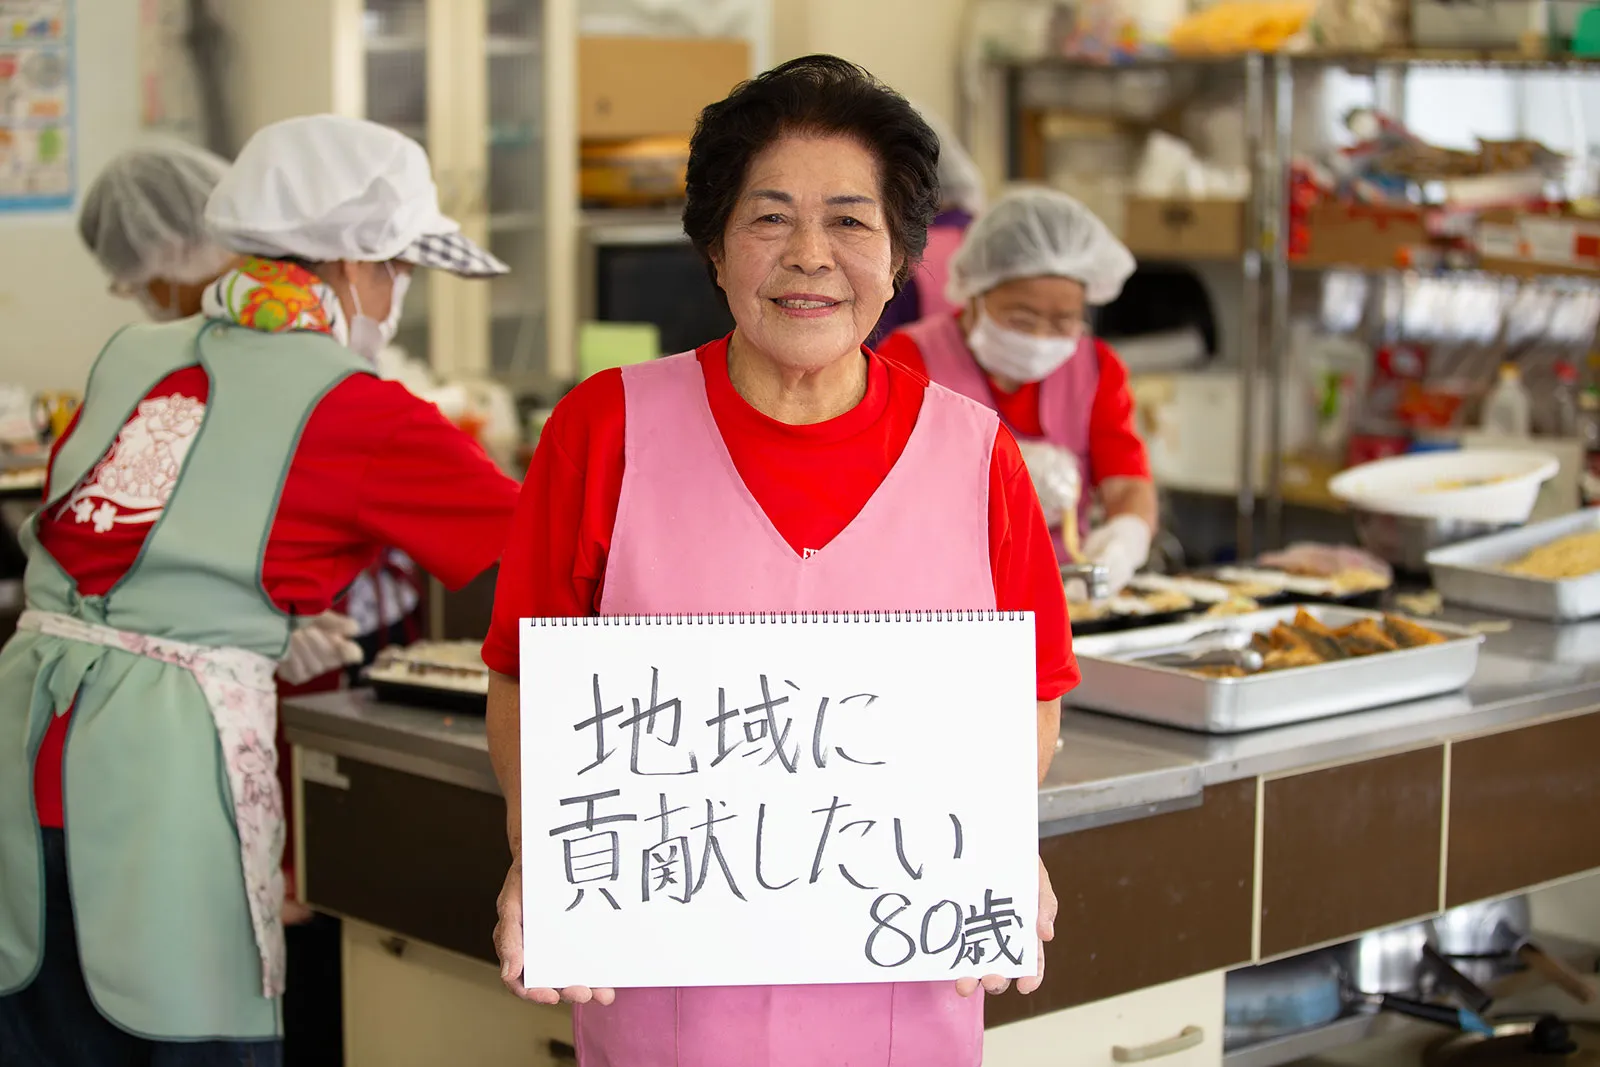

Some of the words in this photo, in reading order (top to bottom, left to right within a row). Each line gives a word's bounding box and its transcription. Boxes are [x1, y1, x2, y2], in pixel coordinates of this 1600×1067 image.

[574, 666, 886, 776] 地域に
[549, 789, 963, 911] 貢献したい
[865, 889, 1024, 970] 80歳
